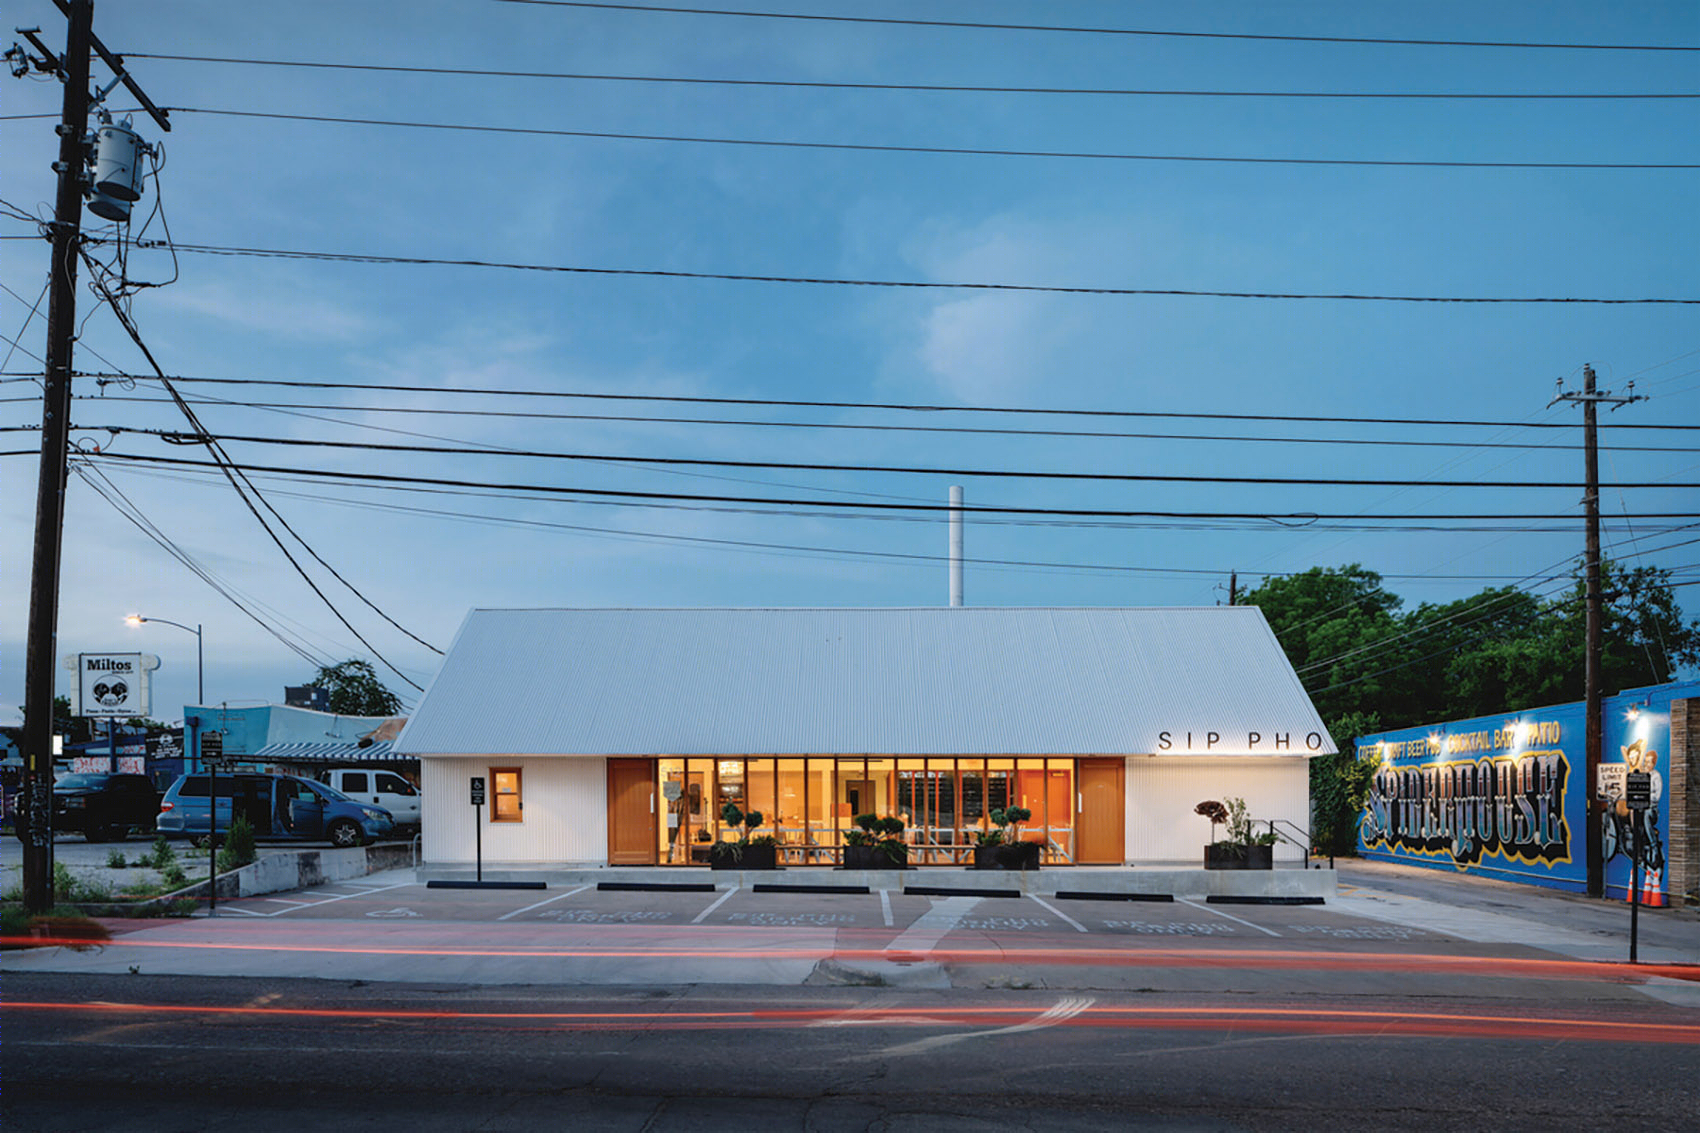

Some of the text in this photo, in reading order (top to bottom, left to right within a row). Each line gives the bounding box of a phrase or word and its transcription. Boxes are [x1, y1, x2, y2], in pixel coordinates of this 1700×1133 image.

[87, 659, 132, 671] Miltos
[1158, 731, 1322, 750] SIP PHO
[1408, 740, 1425, 758] BEER
[1447, 730, 1490, 753] COCKTAIL
[1493, 728, 1515, 749] BAR
[1527, 721, 1561, 746] PATIO
[1600, 766, 1625, 774] SPEED
